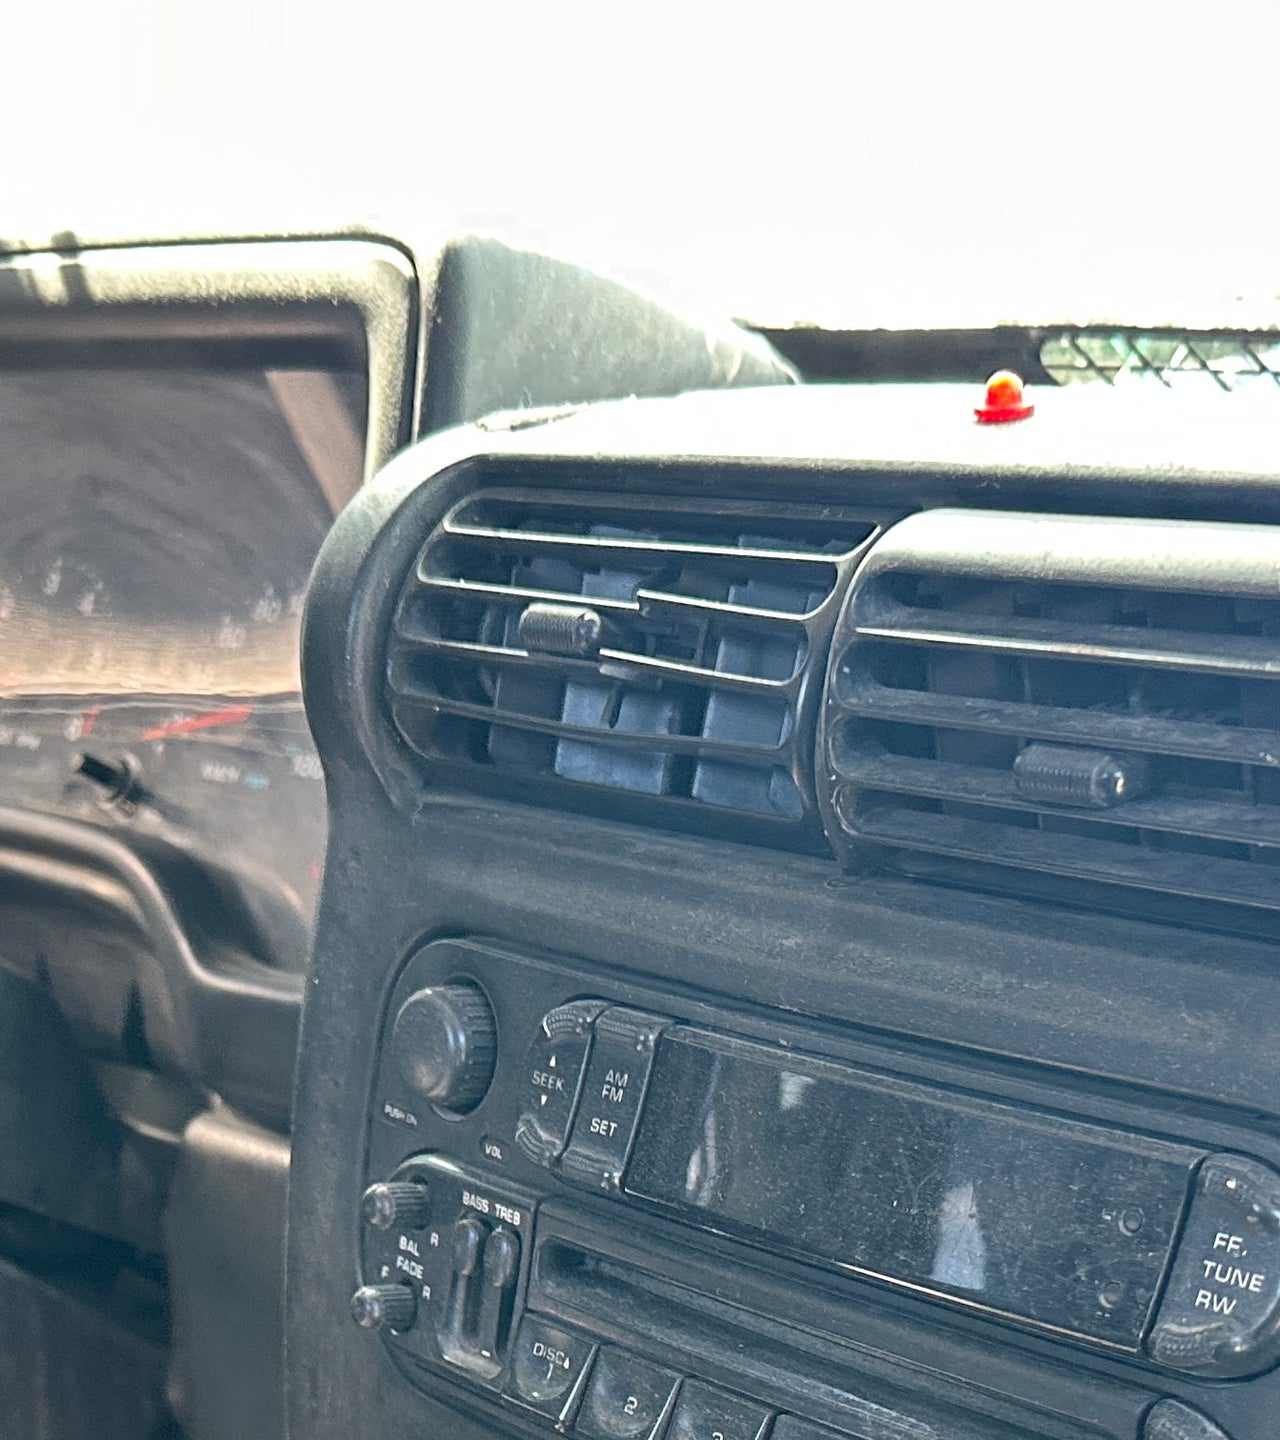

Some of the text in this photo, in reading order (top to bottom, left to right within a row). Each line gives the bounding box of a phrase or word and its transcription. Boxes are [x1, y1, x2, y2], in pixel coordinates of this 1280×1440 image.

[531, 1070, 564, 1092] SEEK
[605, 1069, 628, 1089] AM
[601, 1085, 624, 1104] FM
[590, 1118, 617, 1138] SET
[485, 1144, 502, 1160] VOL
[462, 1191, 521, 1226] BASS TREB
[398, 1234, 420, 1257] BAL
[1213, 1231, 1243, 1253] FF
[396, 1255, 424, 1279] FADE
[1203, 1260, 1265, 1293] TUNE
[1195, 1289, 1237, 1315] RW
[532, 1342, 565, 1365] DISC
[624, 1396, 638, 1415] 2
